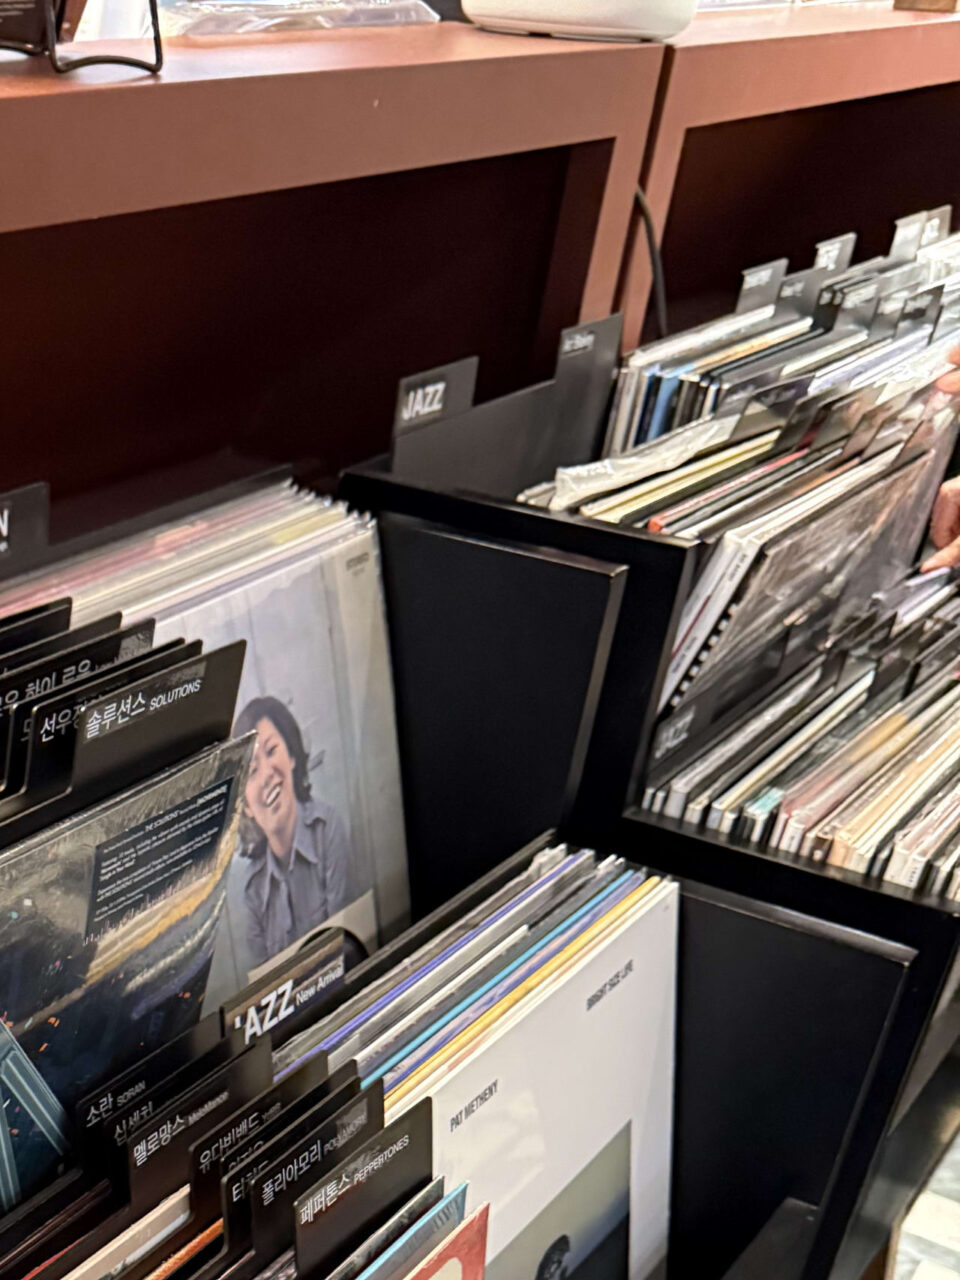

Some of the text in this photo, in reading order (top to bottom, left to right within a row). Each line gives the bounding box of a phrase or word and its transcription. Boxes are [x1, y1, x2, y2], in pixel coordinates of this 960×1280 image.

[401, 381, 446, 420] JAZZ
[85, 692, 146, 739] 솔루션스
[149, 678, 202, 711] SOLUTIONS
[40, 698, 96, 743] 선우
[295, 985, 316, 1006] New
[85, 1092, 114, 1128] 소란
[450, 1079, 498, 1133] PAT METHENY
[133, 1114, 186, 1167] 멜로망스
[353, 1134, 410, 1185] PEPPERTONES
[261, 1139, 323, 1206] 폴리아모리
[299, 1171, 352, 1225] 페퍼톤스
